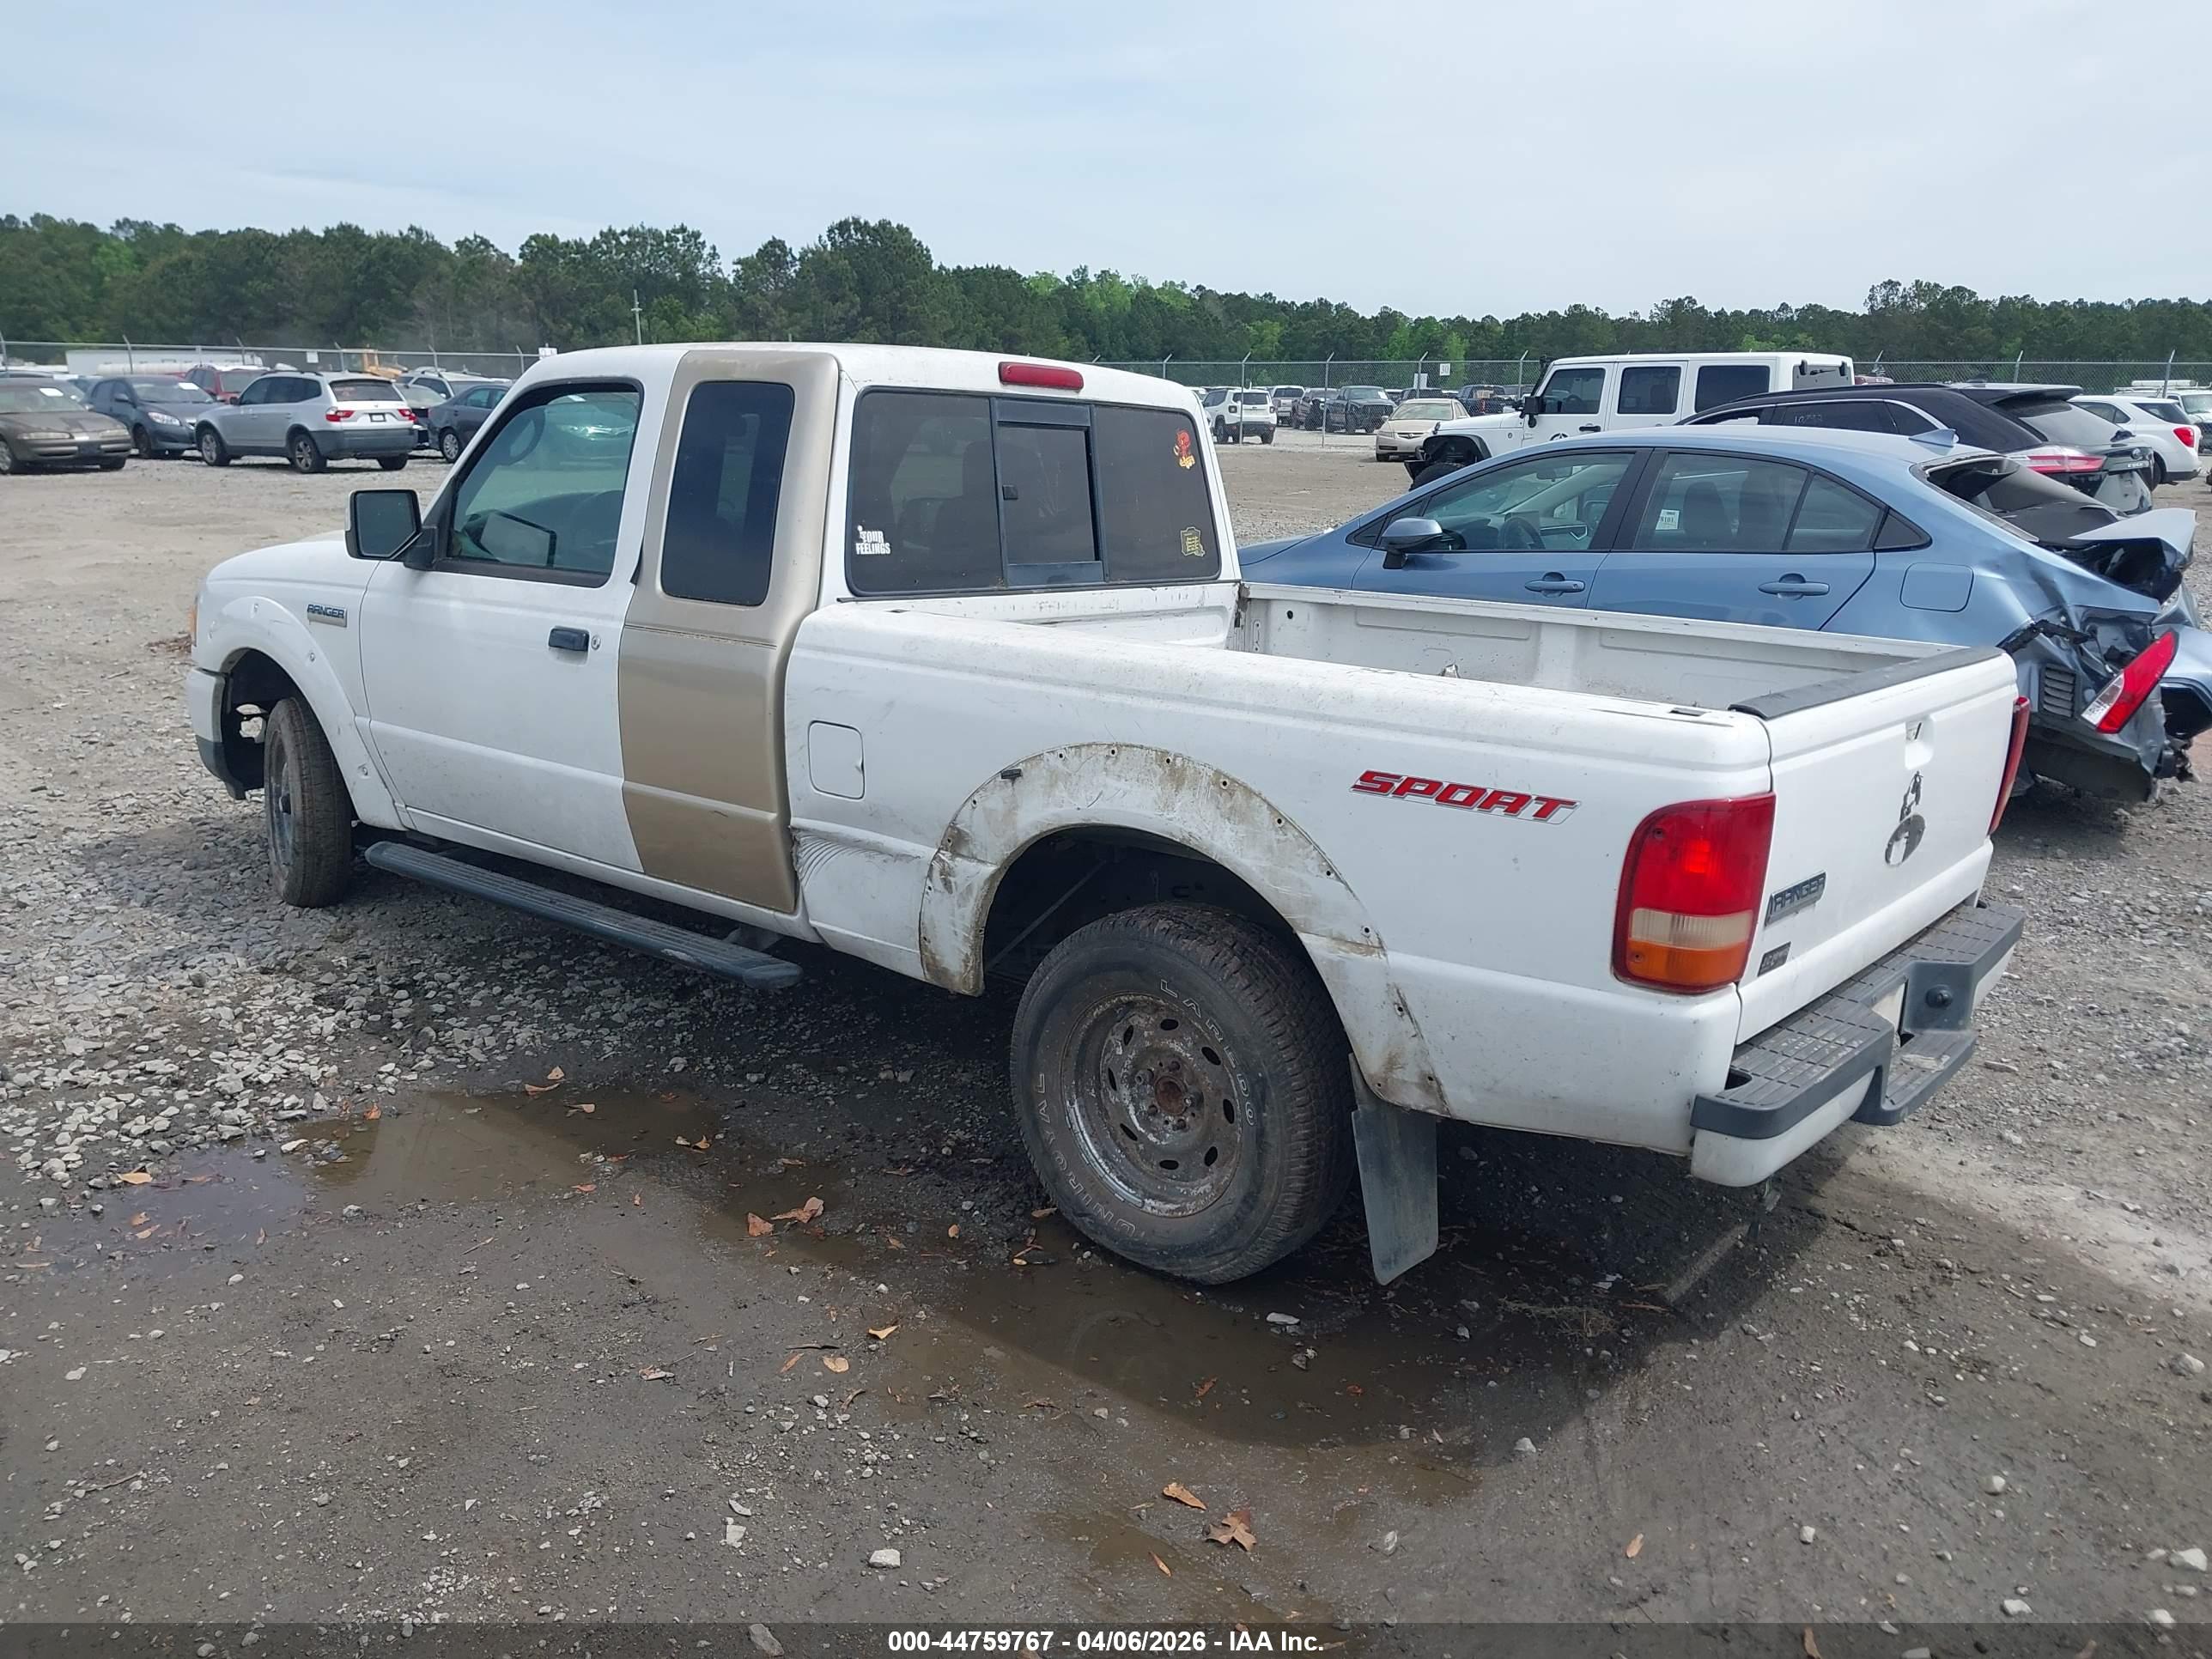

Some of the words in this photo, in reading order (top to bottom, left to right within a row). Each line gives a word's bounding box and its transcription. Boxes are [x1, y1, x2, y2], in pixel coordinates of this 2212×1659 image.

[855, 542, 891, 555] FEELINGS
[307, 604, 345, 619] RANGER
[1351, 769, 1578, 822] SPORT
[1773, 875, 1826, 914] RANGER
[1160, 978, 1256, 1127] LAREDO
[1036, 1073, 1137, 1237] UNIROYAL
